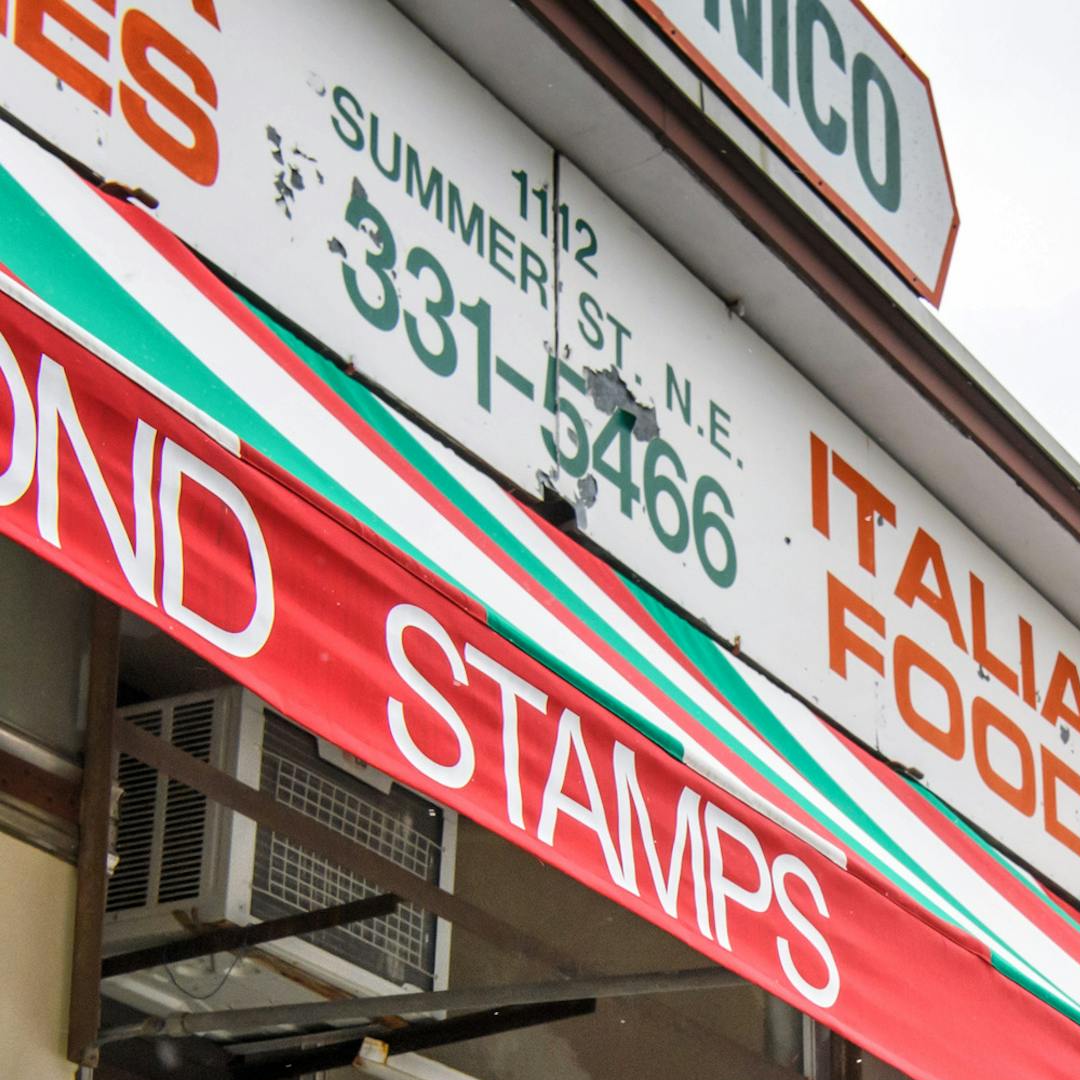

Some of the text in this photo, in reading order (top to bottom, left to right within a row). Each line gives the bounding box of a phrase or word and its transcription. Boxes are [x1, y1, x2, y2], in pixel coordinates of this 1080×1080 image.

[0, 0, 219, 187] ES
[331, 85, 745, 470] SUMMER ST. N.E.
[511, 170, 599, 279] 1112
[341, 194, 738, 589] 331-5466
[385, 603, 841, 1008] STAMPS
